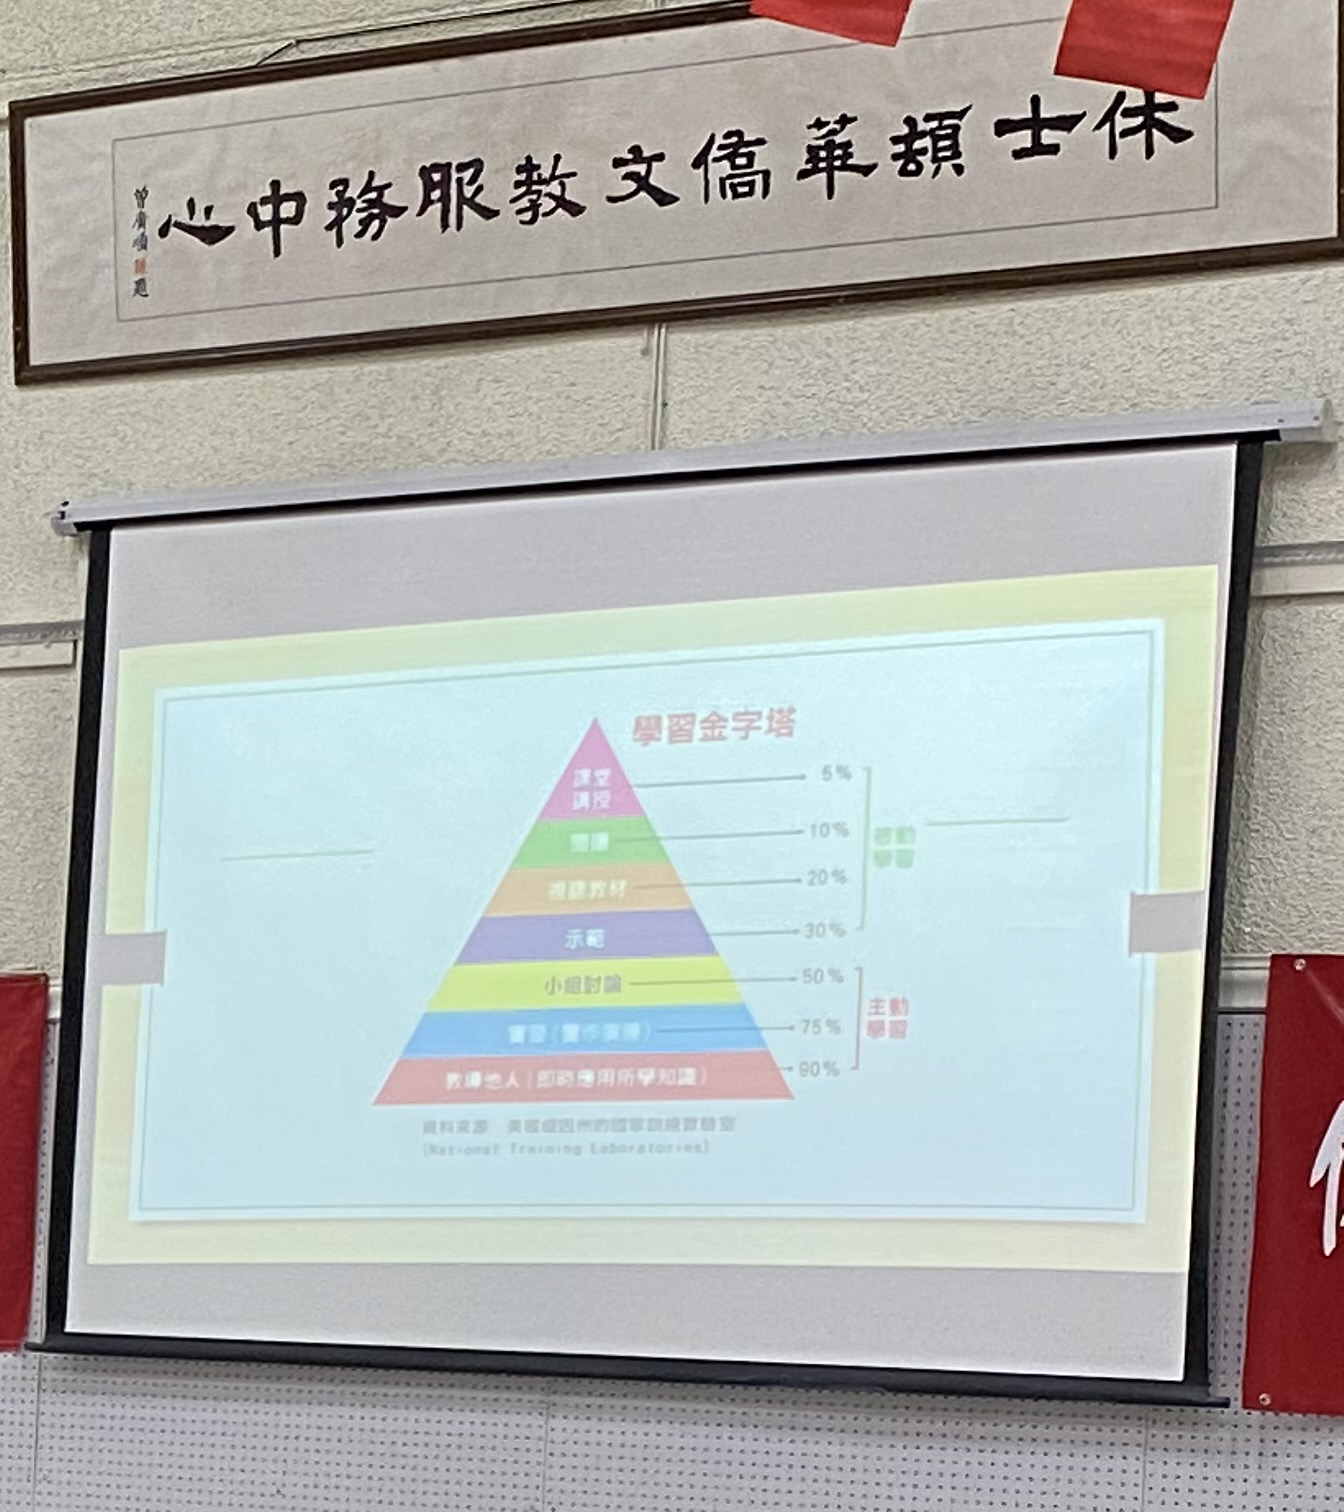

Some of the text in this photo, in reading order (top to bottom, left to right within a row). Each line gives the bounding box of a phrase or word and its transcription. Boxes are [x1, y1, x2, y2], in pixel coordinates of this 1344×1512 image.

[632, 705, 798, 746] 學習金字塔
[821, 765, 853, 782] 5%
[810, 821, 851, 838] 10%
[806, 869, 848, 887] 20%
[803, 922, 847, 939] 30%
[801, 968, 845, 985] 50%
[801, 1019, 842, 1036] 75%
